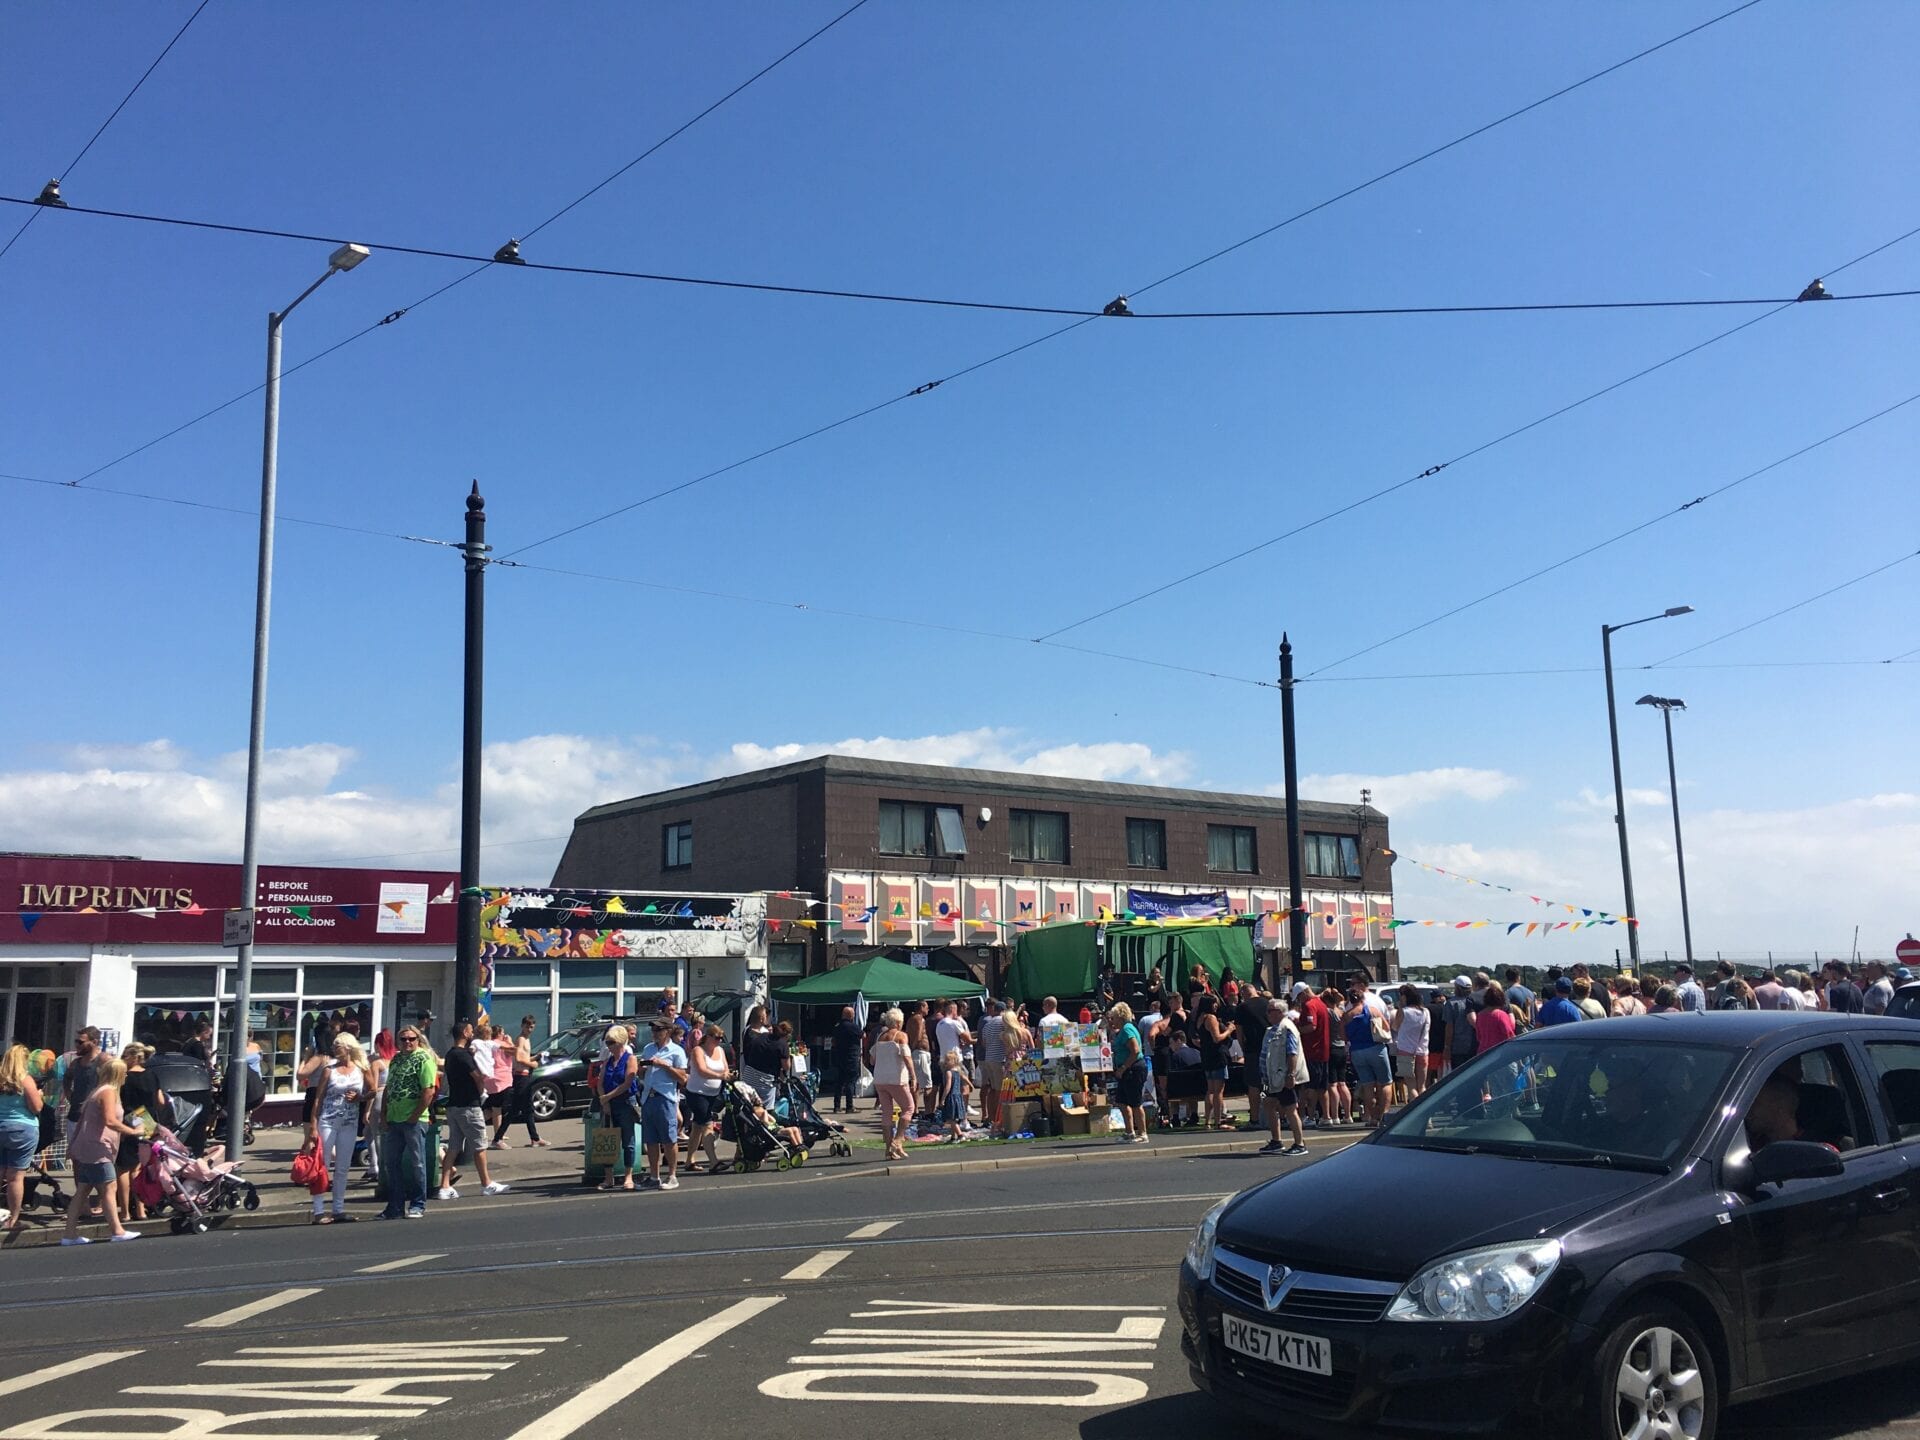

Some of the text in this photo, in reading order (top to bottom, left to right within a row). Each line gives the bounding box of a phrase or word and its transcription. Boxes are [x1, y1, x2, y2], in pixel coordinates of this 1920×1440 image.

[268, 881, 309, 890] BESPOKE
[19, 883, 193, 910] IMPRINTS
[267, 893, 333, 903] PERSONALISED
[266, 905, 292, 914] GIFTS
[264, 918, 281, 926] ALL
[1228, 1319, 1322, 1370] PK57 KTN
[757, 1299, 1168, 1407] ONLY
